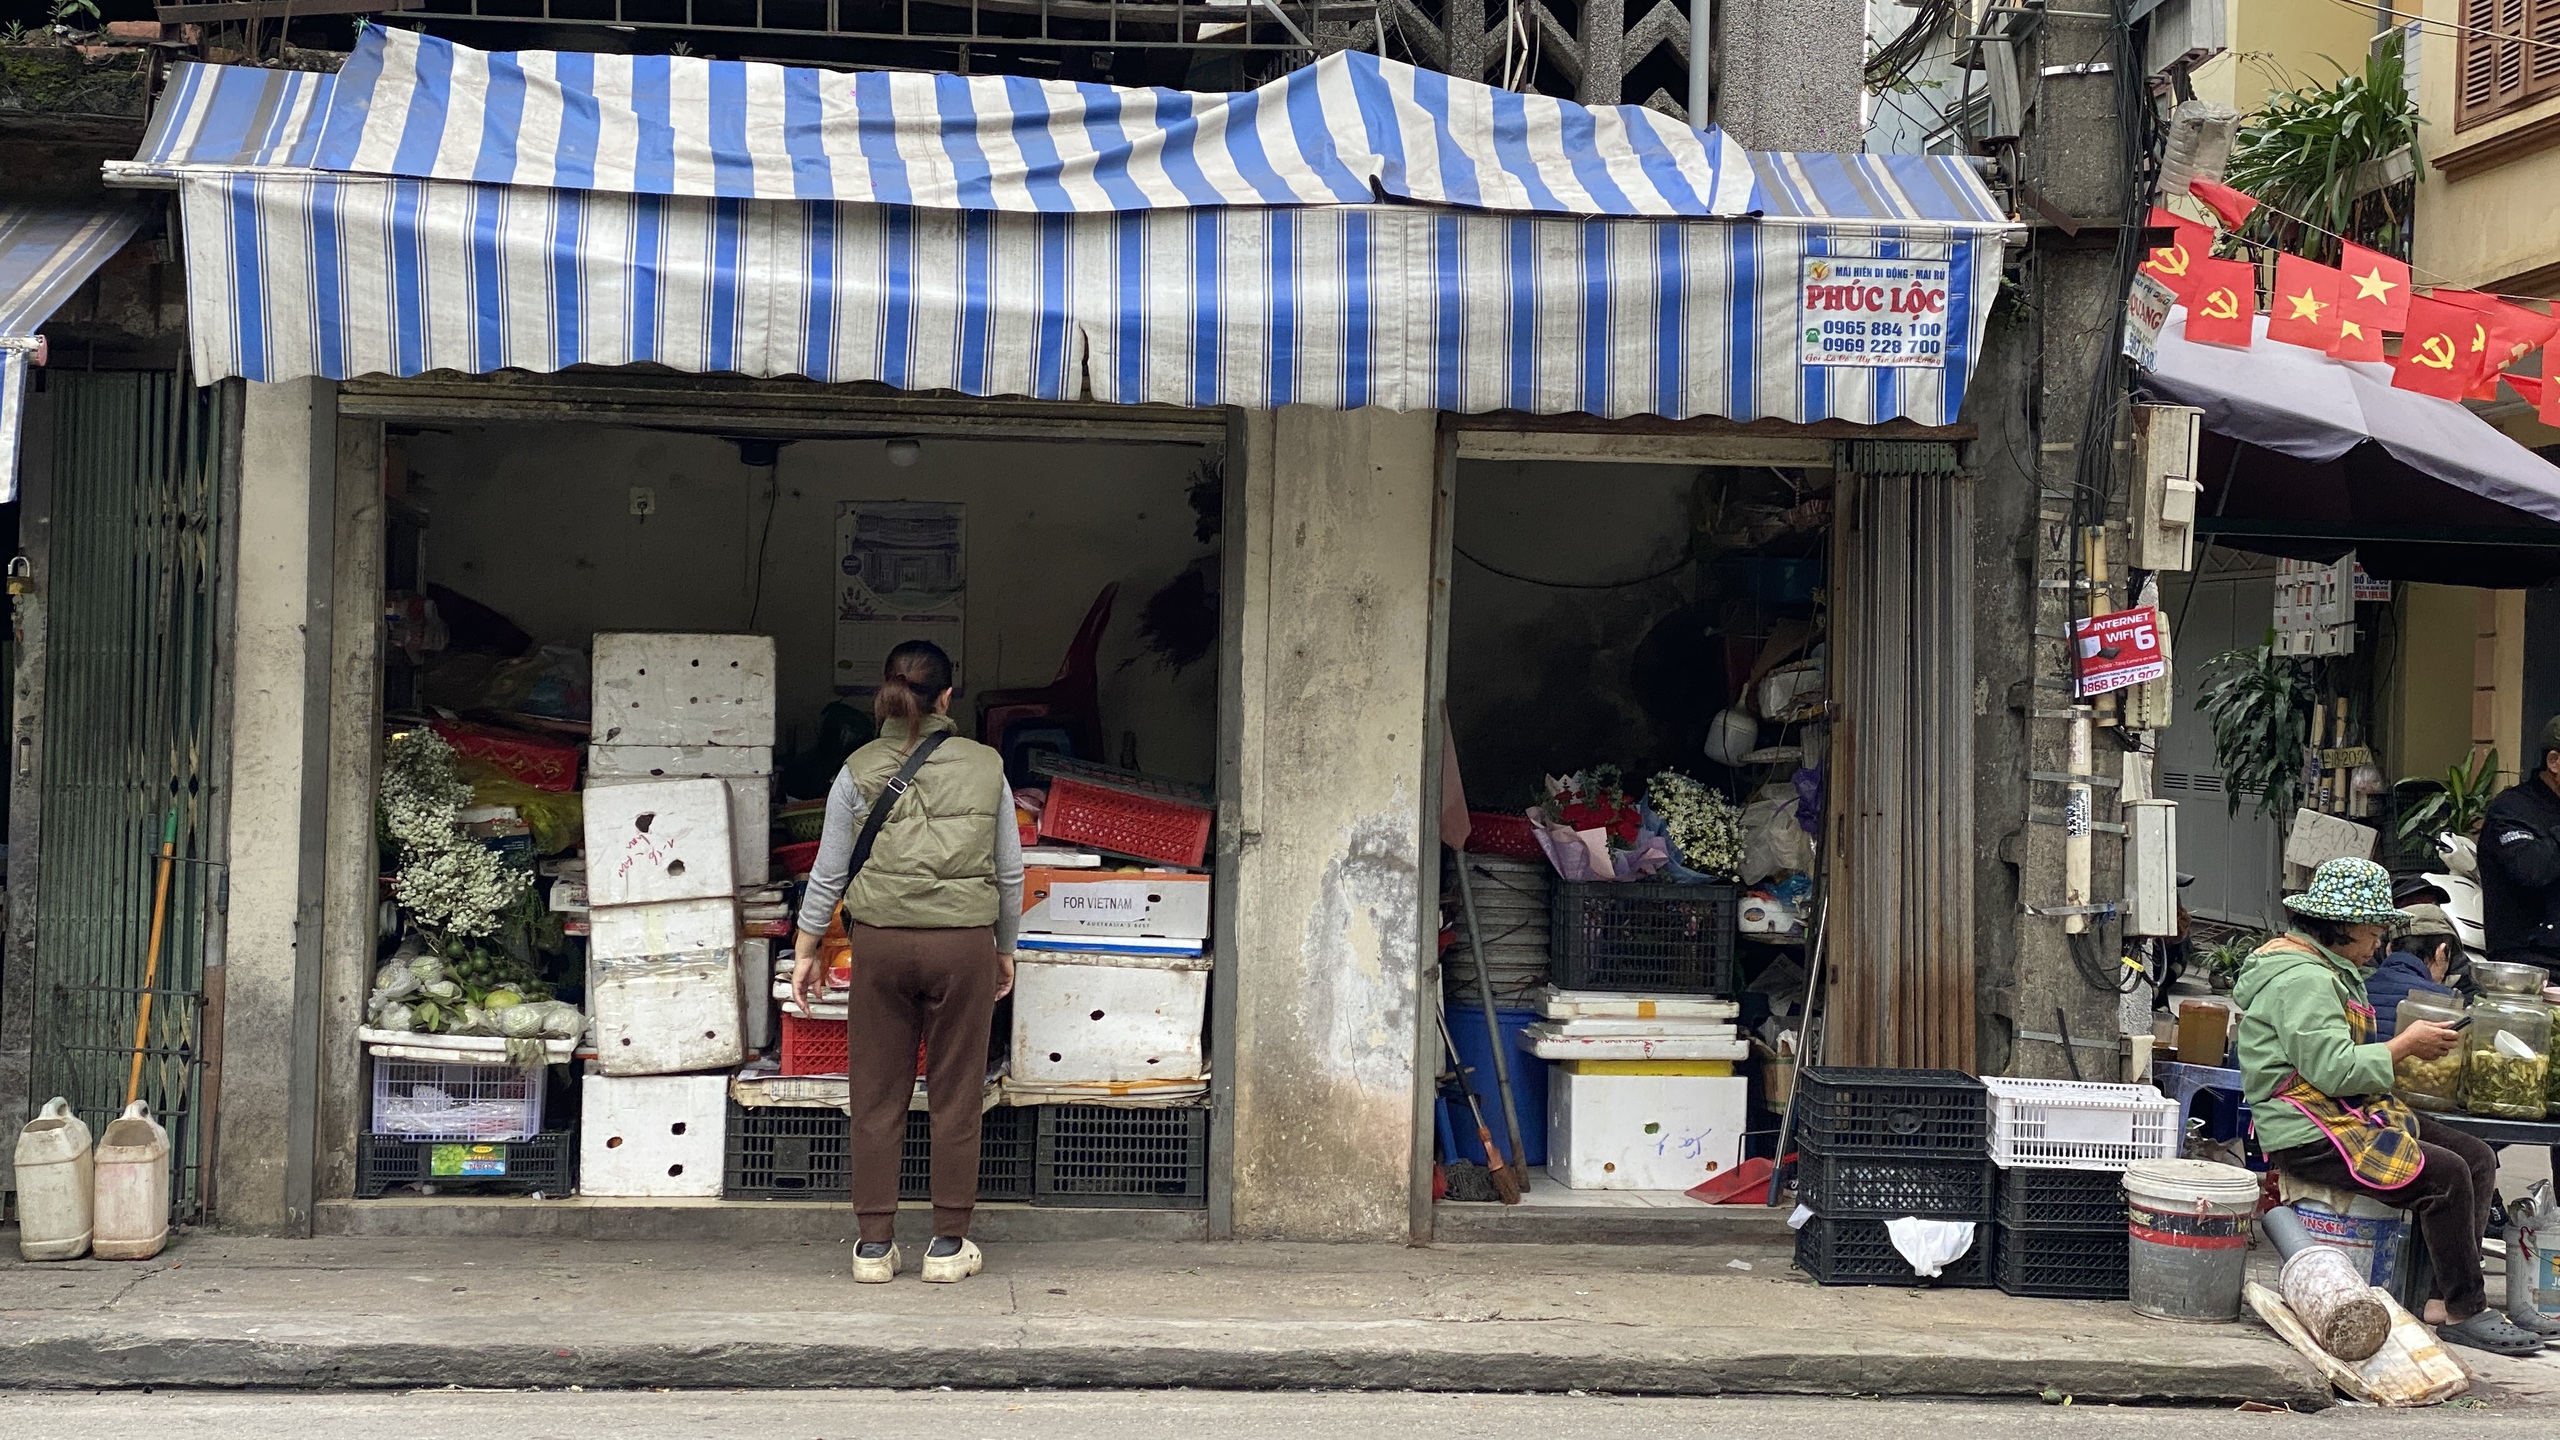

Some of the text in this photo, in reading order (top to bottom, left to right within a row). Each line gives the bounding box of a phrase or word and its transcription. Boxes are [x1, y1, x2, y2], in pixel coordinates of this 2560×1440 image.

[1874, 268, 1884, 278] DI
[1886, 267, 1909, 281] ĐỘNG
[1806, 279, 1945, 321] PHÚC LỘC
[1822, 320, 1941, 337] 0965 884 100
[1822, 337, 1941, 354] 0969 228 700
[2094, 612, 2150, 631] INTERNET
[2105, 624, 2156, 650] WIFI 6
[1063, 896, 1133, 910] FOR VIETNAM
